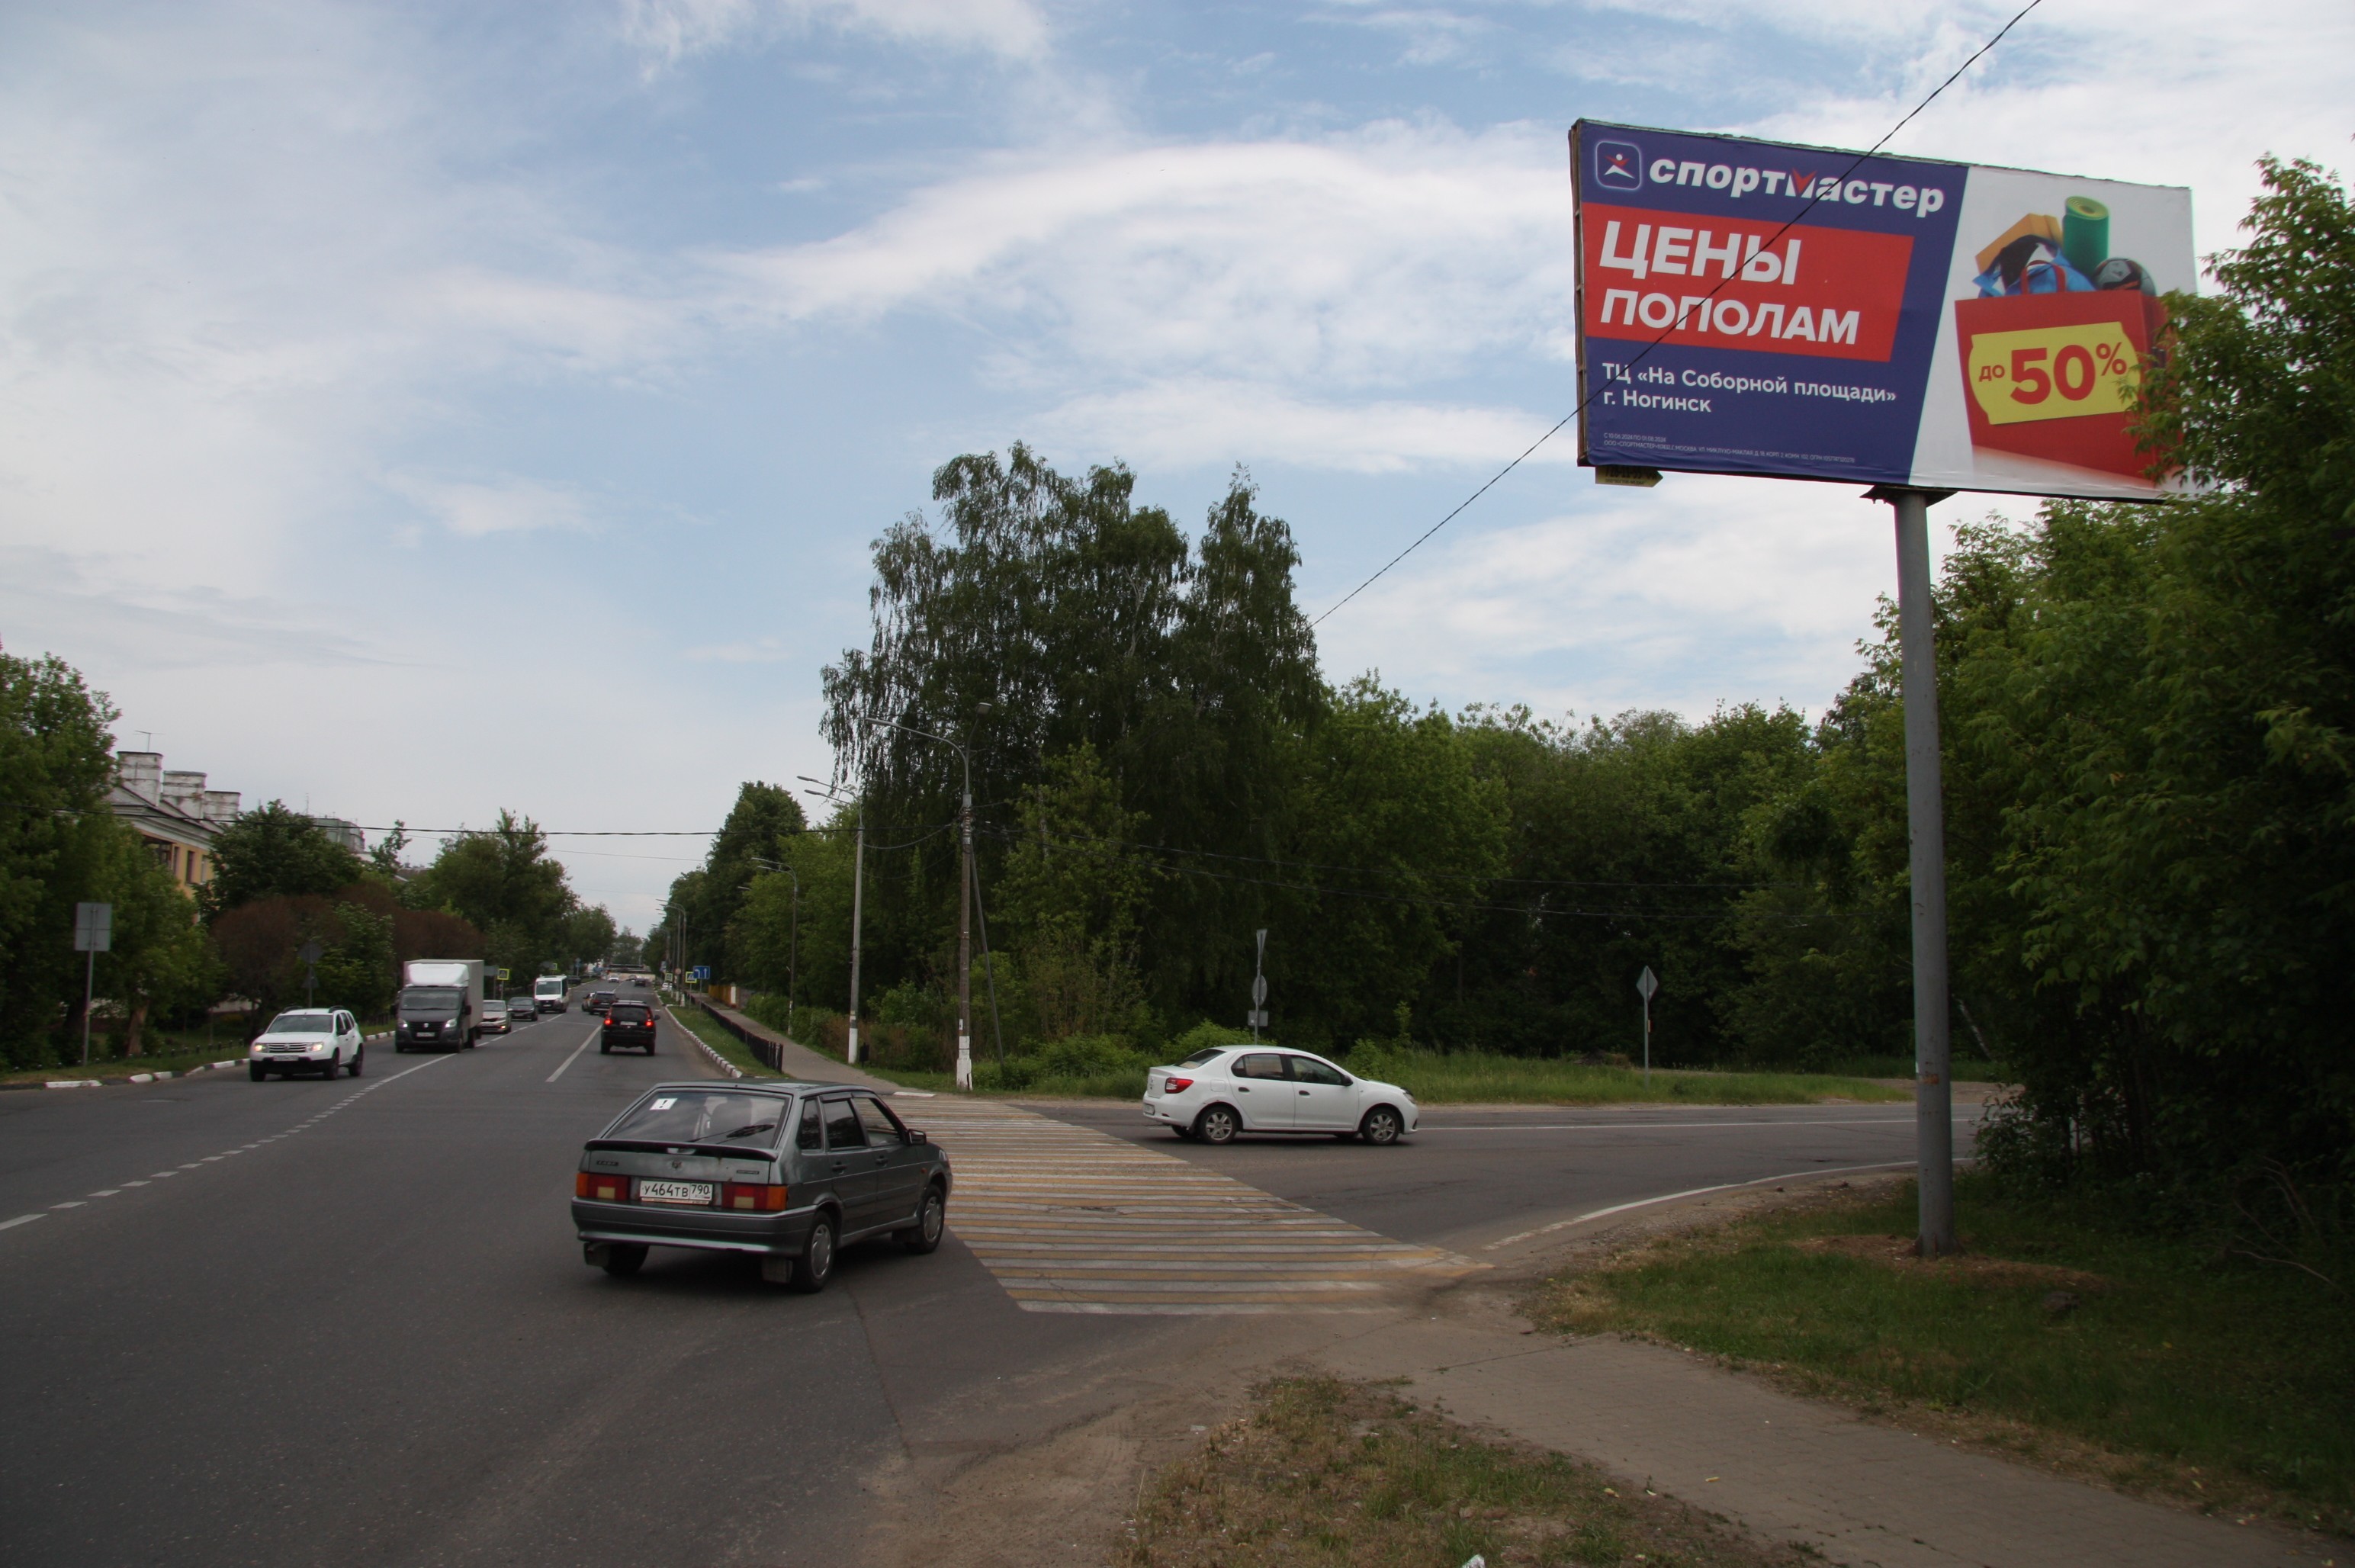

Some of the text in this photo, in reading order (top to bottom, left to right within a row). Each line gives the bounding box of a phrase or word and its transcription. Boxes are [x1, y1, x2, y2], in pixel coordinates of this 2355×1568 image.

[1599, 220, 1801, 285] ЦЕНЫ
[1600, 288, 1861, 345] ПОПОЛАМ
[1602, 362, 1897, 403] ТЦ «На Соборной площади»
[1978, 341, 2127, 406] до 50%
[1603, 390, 1712, 413] г. Ногинск
[644, 1183, 709, 1197] У464ТВ 790
